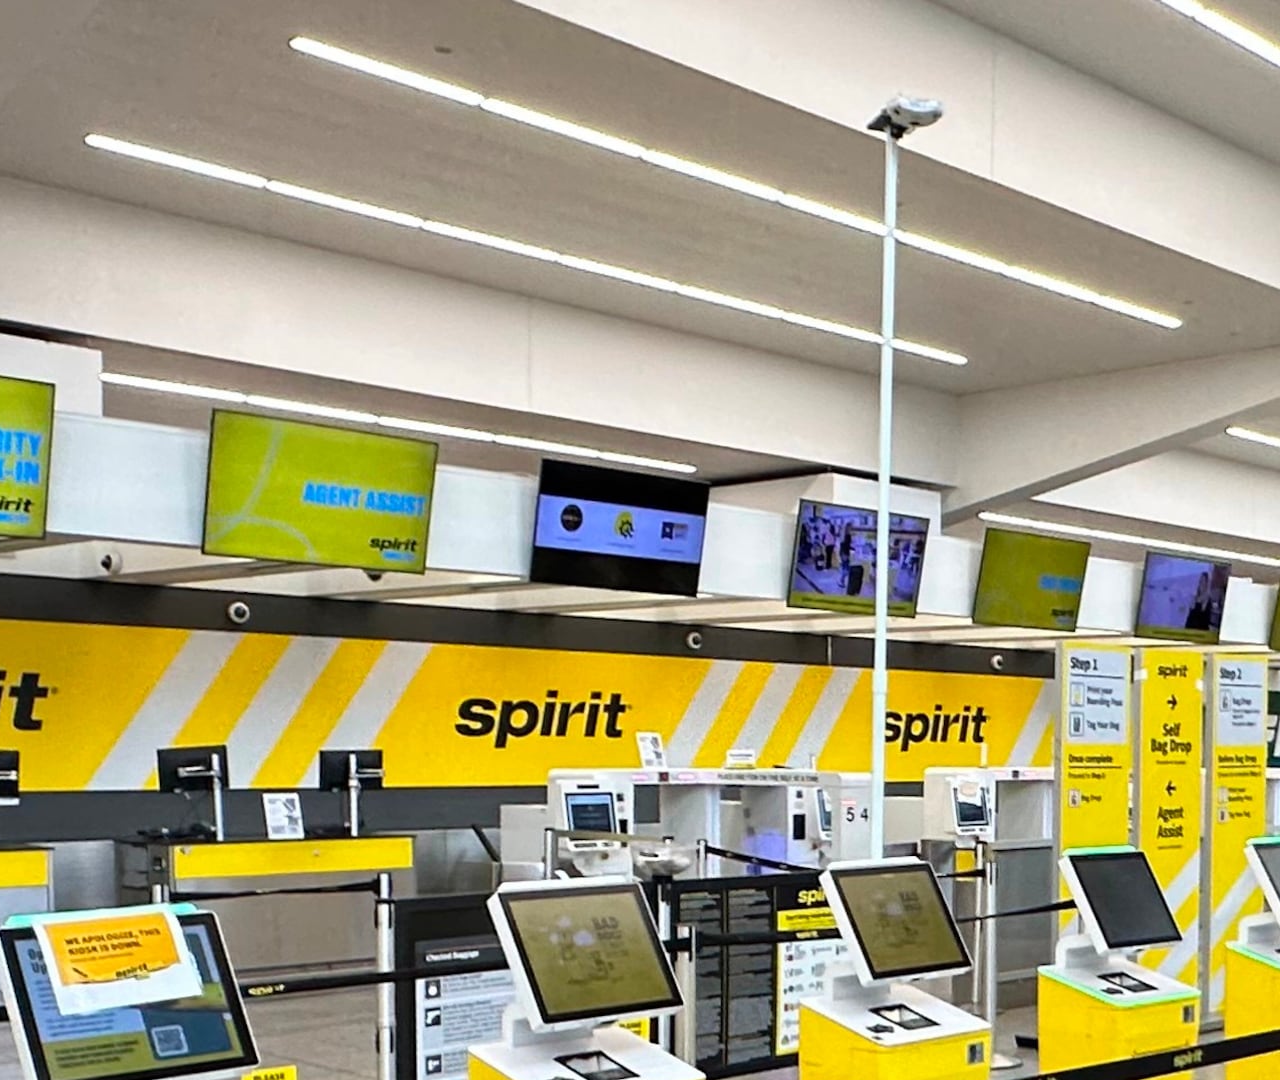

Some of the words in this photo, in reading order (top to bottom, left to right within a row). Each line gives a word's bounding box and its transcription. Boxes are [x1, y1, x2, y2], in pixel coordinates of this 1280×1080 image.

[302, 482, 362, 507] AGENT
[364, 491, 427, 516] ASSIST
[369, 537, 418, 552] spirit
[1092, 658, 1098, 671] 1
[1157, 664, 1189, 678] spirit
[455, 689, 628, 748] spirit
[885, 704, 988, 752] spirit
[1163, 722, 1181, 737] Self
[1151, 739, 1168, 756] Bag
[1170, 739, 1191, 756] Drop
[846, 806, 856, 822] 5
[860, 808, 869, 822] 4
[1157, 806, 1184, 824] Agent
[1157, 824, 1184, 839] Assist
[99, 943, 110, 952] IS
[1173, 1049, 1203, 1068] spirit
